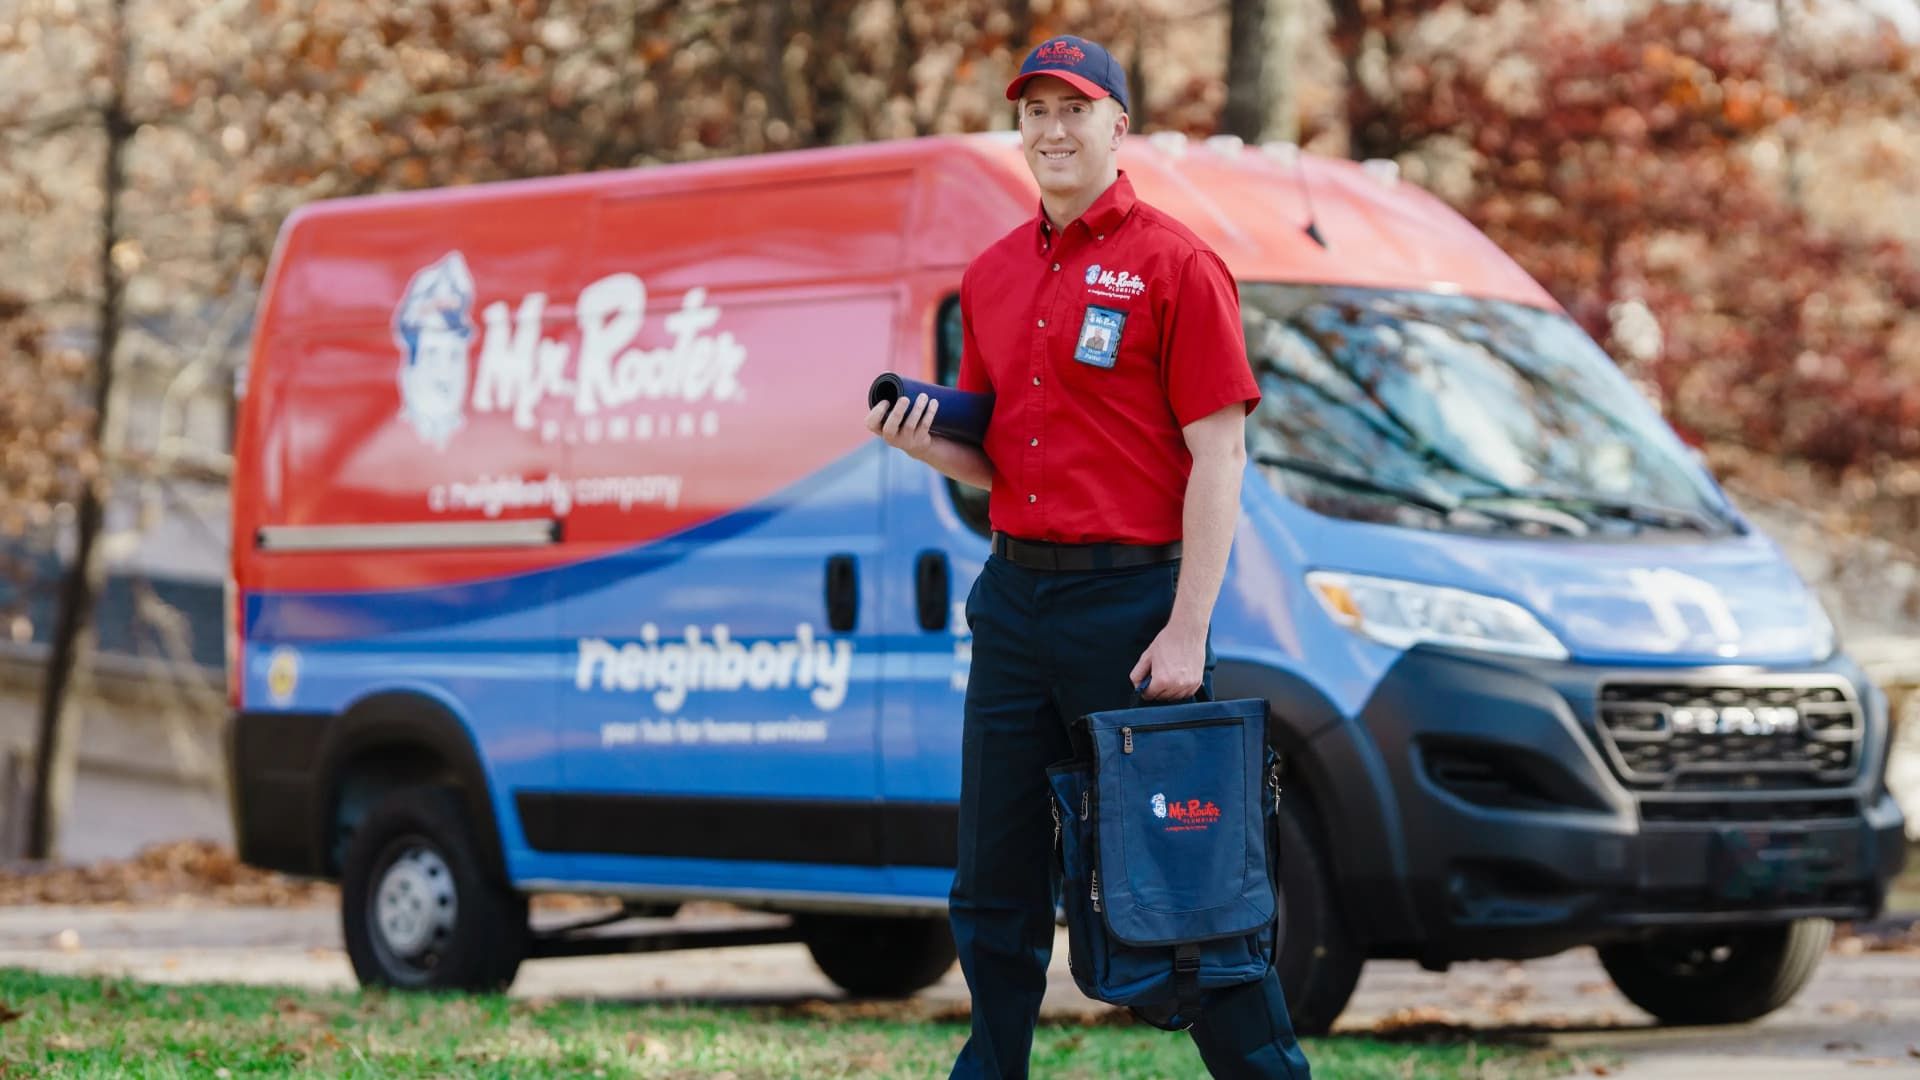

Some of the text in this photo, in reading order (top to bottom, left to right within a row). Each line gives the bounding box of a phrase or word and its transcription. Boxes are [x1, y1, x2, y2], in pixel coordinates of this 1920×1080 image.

[1098, 270, 1145, 291] Mr. Rooter
[1108, 285, 1140, 296] PLUMBING
[472, 271, 747, 429] Mr. Rooter
[541, 409, 719, 443] PLUMBING
[450, 473, 572, 518] neighborly
[574, 476, 682, 512] company
[575, 622, 852, 712] neighborly
[755, 715, 828, 744] services
[1187, 799, 1221, 818] Rooter
